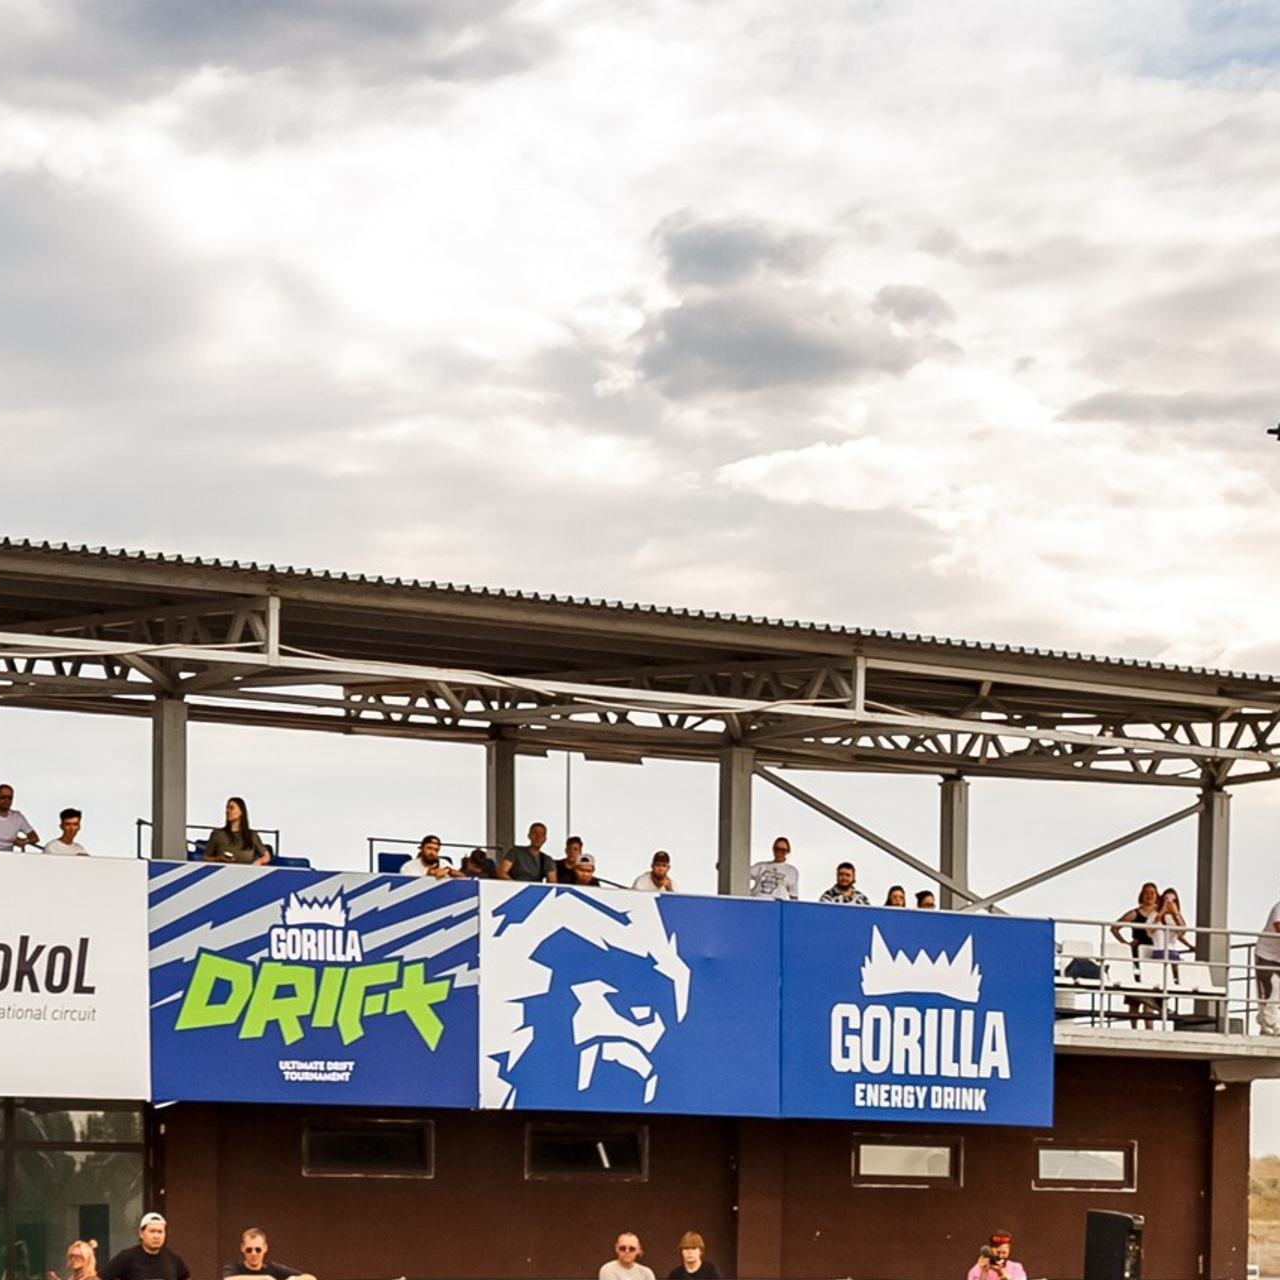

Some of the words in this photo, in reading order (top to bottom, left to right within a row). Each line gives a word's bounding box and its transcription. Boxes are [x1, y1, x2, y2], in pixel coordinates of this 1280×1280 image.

[271, 928, 362, 962] GORILLA
[51, 1005, 97, 1022] circuit
[174, 952, 451, 1052] DRIFT
[830, 1003, 1011, 1079] GORILLA
[279, 1060, 325, 1072] ULTIMATE
[326, 1061, 355, 1072] DRIFT
[282, 1070, 351, 1082] TOURNAMENT
[854, 1083, 927, 1109] ENERGY
[930, 1085, 987, 1111] DRINK
